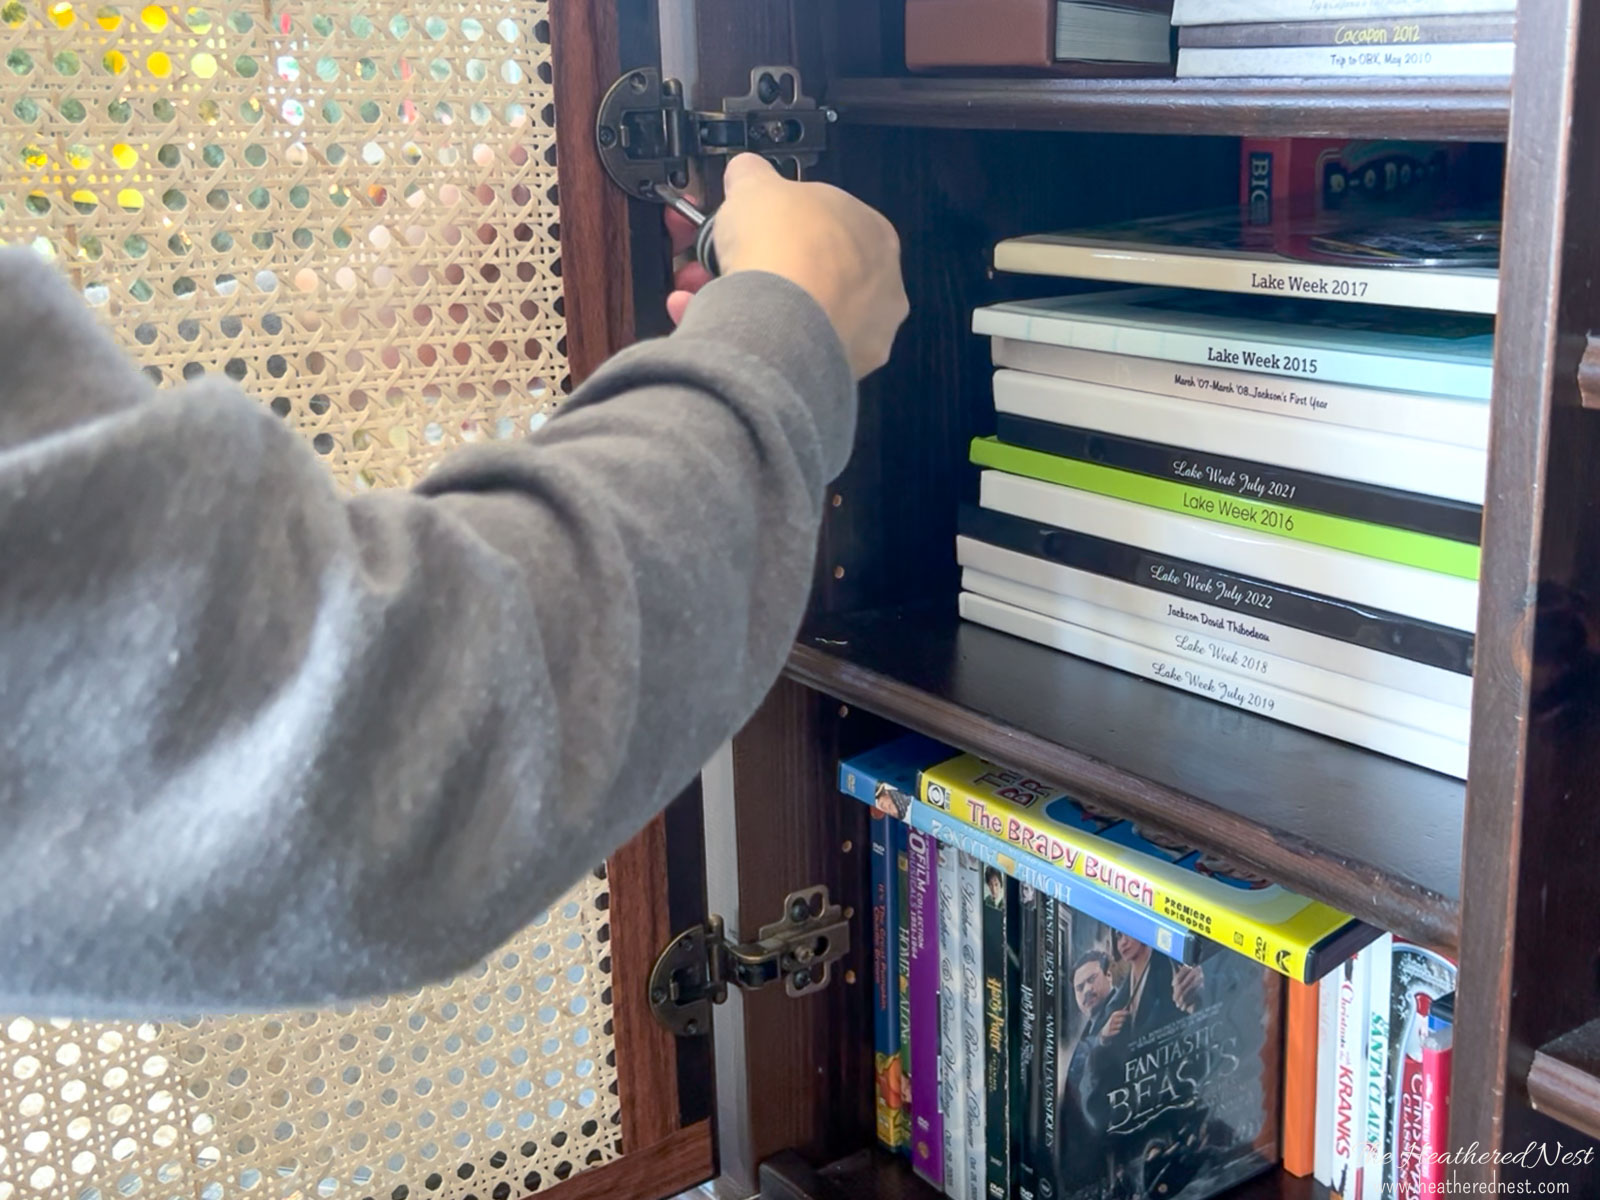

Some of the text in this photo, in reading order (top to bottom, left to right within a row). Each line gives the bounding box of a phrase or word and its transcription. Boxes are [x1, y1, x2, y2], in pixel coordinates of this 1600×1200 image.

[1334, 25, 1421, 45] Cacapon 2012
[1330, 53, 1346, 68] Trip
[1348, 54, 1357, 65] to
[1384, 53, 1401, 68] May
[1404, 52, 1432, 64] 2010
[1251, 273, 1368, 297] Lake Week 2017
[1208, 347, 1318, 374] Lake Week 2015
[1174, 373, 1196, 387] March
[1289, 392, 1307, 406] First
[1309, 396, 1328, 411] Year
[1173, 460, 1296, 499] Lake Week July 2021
[1183, 492, 1294, 531] Lake Week 2016
[1150, 565, 1273, 609] Lake Week July 2022
[1167, 604, 1270, 642] Jackson David Thibodeau
[1175, 635, 1268, 674] Lake Week 2018
[1152, 662, 1275, 711] Lake Week July 2019
[967, 799, 1003, 834] The
[1084, 854, 1154, 907] Bunch
[908, 827, 927, 949] 0 FILM COLLECTION
[909, 851, 917, 908] MUSICALS
[1046, 898, 1055, 945] NTASTIC
[898, 926, 910, 977] HOME
[1042, 950, 1055, 996] BEASTS
[986, 977, 1005, 1053] Harry Potter
[1020, 983, 1034, 1011] Harry
[1340, 983, 1354, 1049] Christmas
[1020, 1009, 1036, 1040] Potter
[1370, 1011, 1384, 1078] SANTA
[1124, 1021, 1223, 1083] FANTASTIC
[1045, 1066, 1055, 1148] FANTASTIQUES
[1106, 1037, 1240, 1132] BEASTS
[1336, 1065, 1354, 1158] KRANKS
